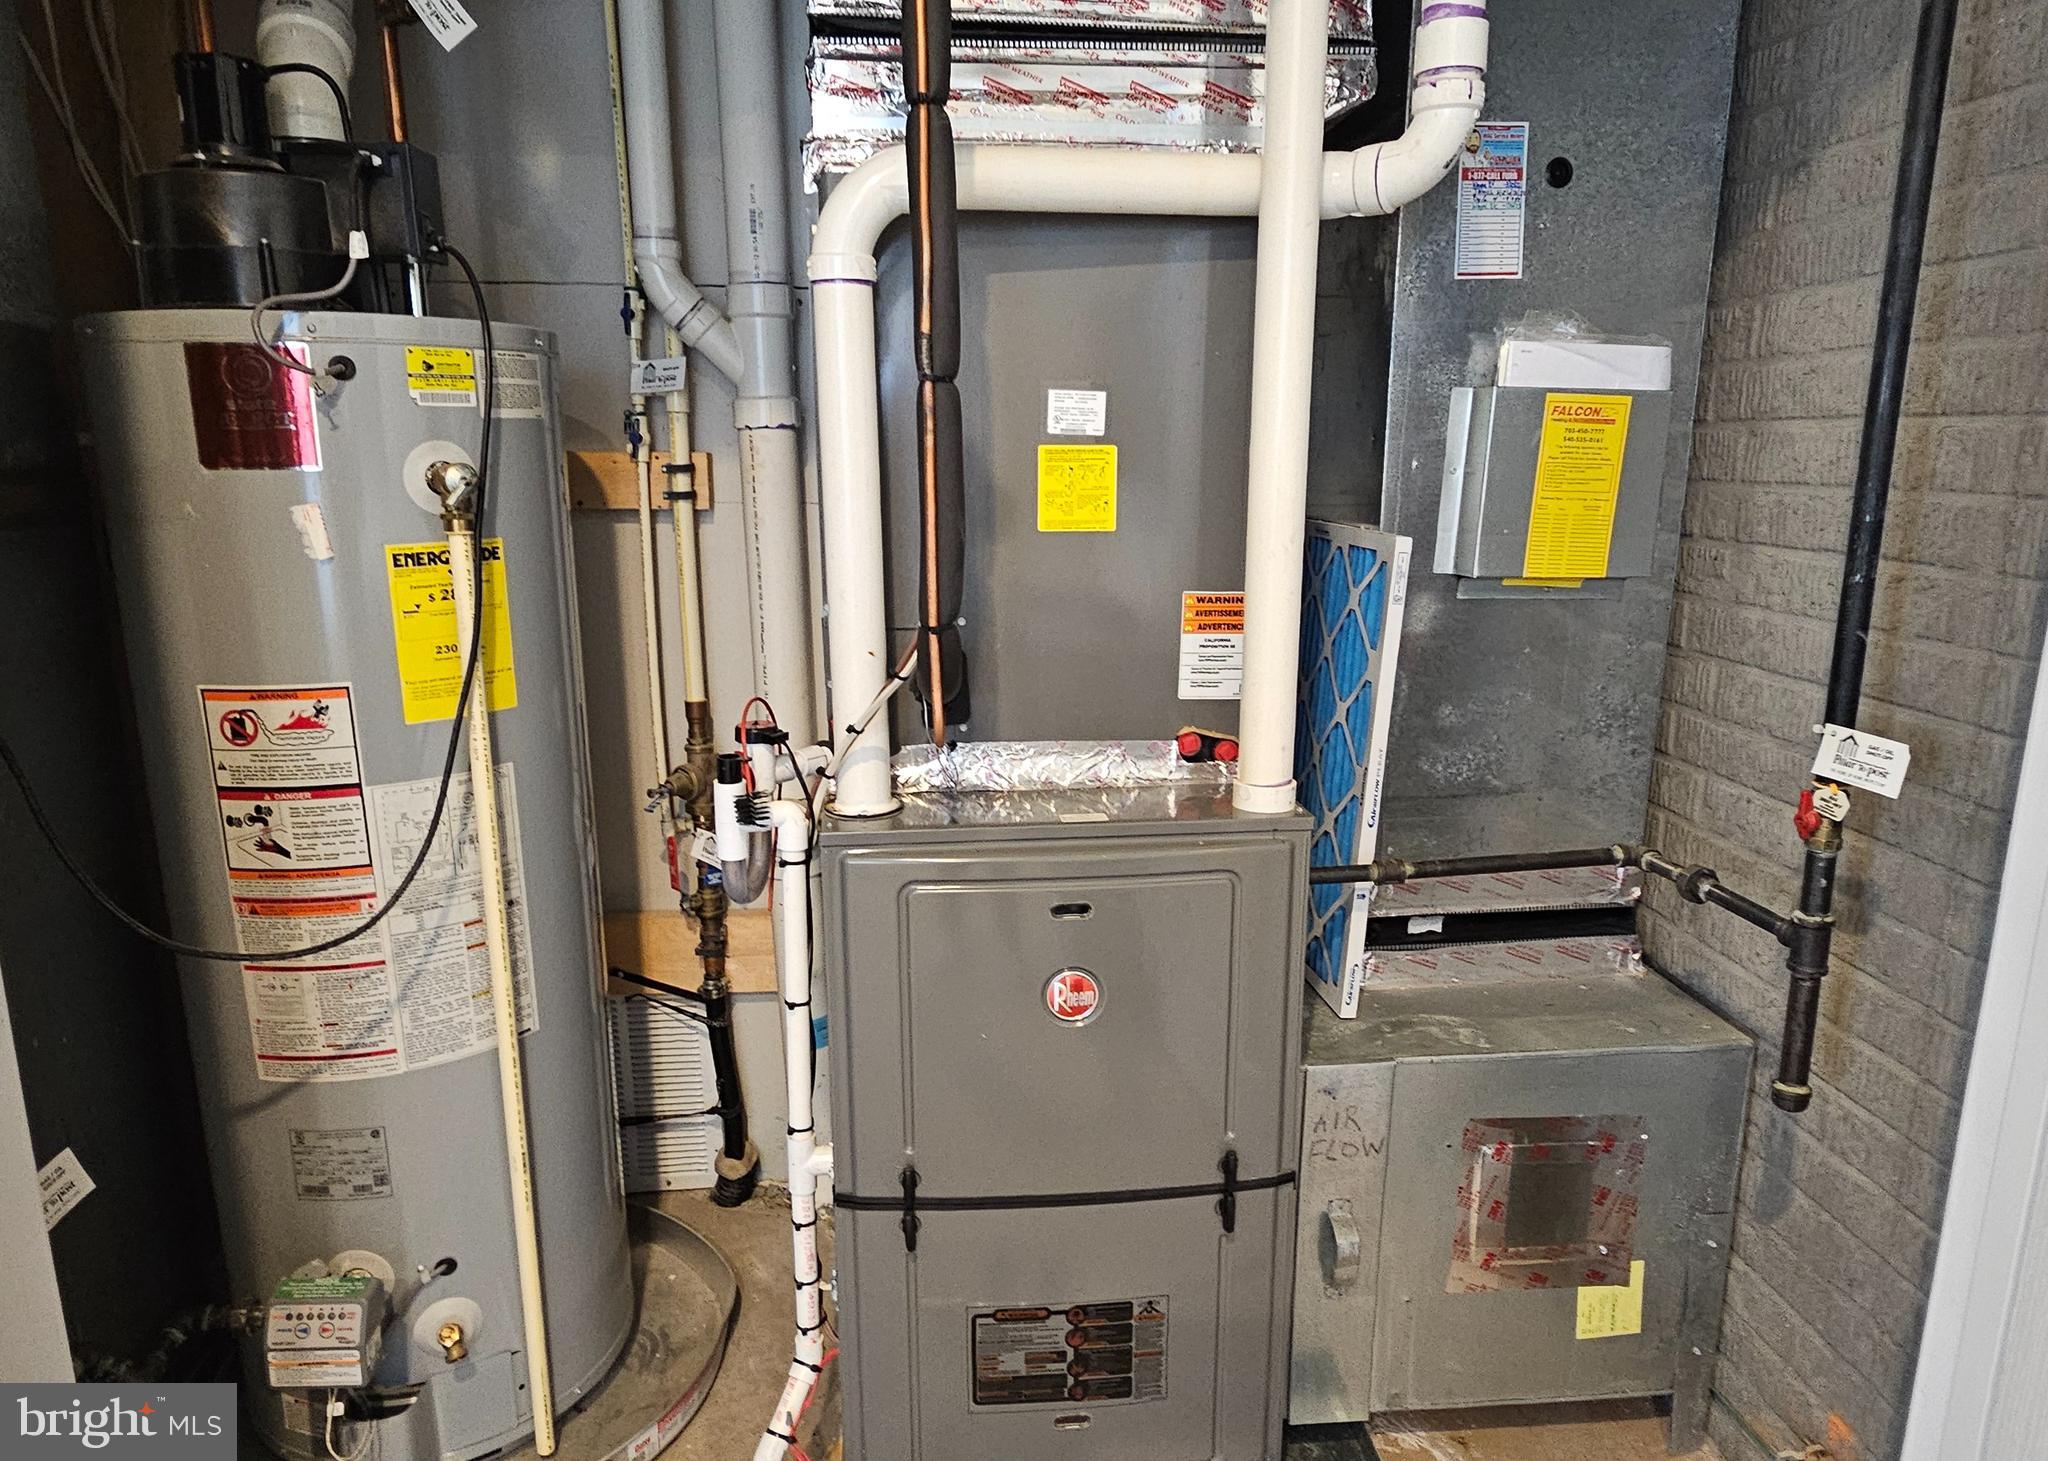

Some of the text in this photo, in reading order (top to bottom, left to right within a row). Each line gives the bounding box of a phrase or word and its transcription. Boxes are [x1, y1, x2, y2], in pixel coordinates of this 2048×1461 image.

[1551, 405, 1602, 417] FALCON
[1196, 596, 1244, 605] WARNIN
[1197, 623, 1244, 631] ADVERTENCI
[435, 643, 458, 655] 230
[257, 692, 298, 700] WARNING
[274, 792, 312, 800] DANGER
[1053, 976, 1095, 1013] Rheem
[1312, 1105, 1361, 1133] AIR
[1311, 1136, 1386, 1161] FLOW
